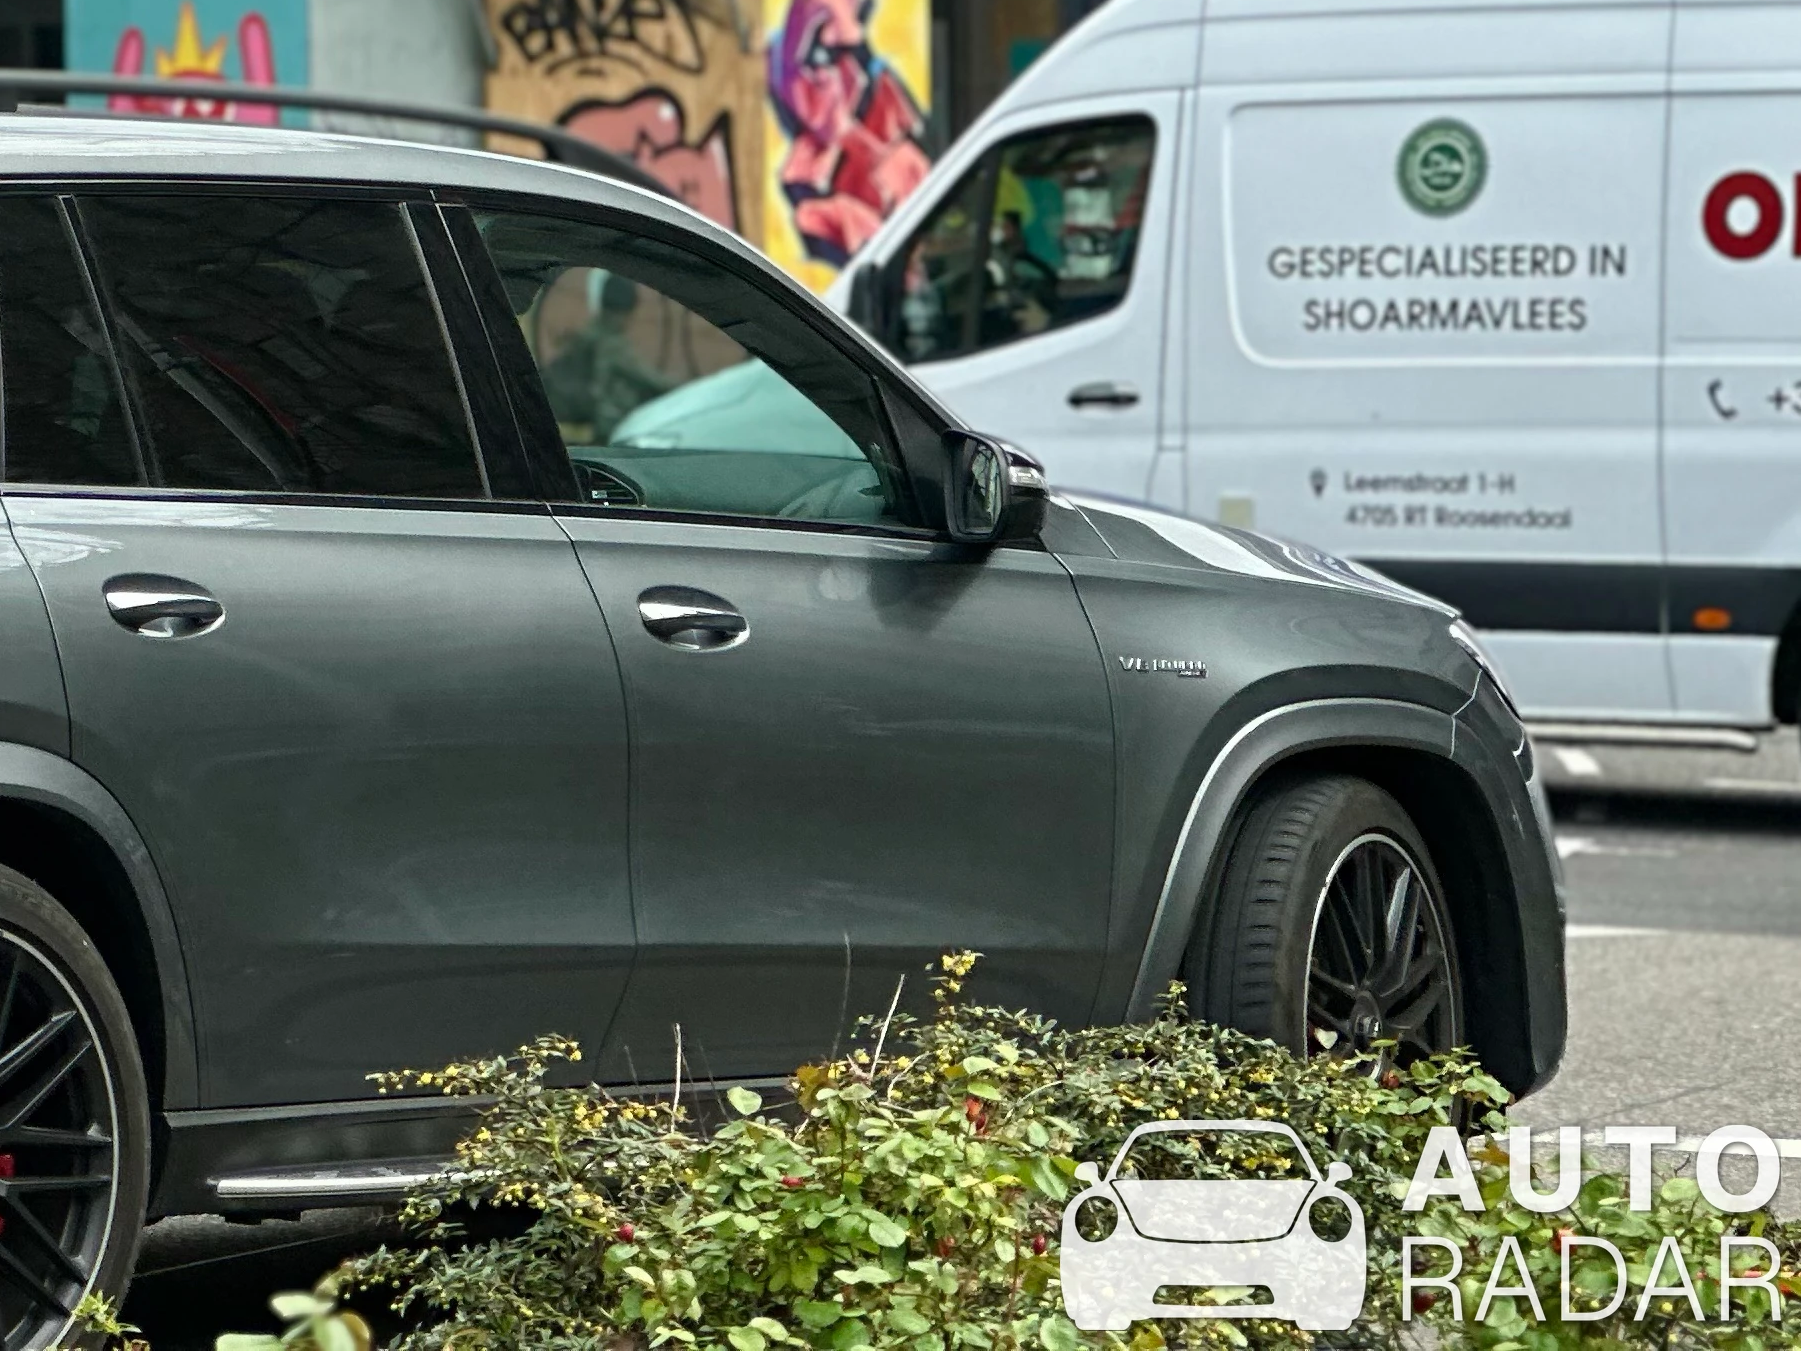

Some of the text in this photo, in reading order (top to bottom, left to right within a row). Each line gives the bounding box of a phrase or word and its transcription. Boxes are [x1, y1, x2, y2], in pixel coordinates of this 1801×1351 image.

[1267, 244, 1627, 280] GESPECIALISEERD IN
[1302, 296, 1588, 333] SHOARMAVLEES
[1344, 470, 1469, 494] Leemstraat
[1346, 503, 1573, 529] 4705 RT Roosendaal
